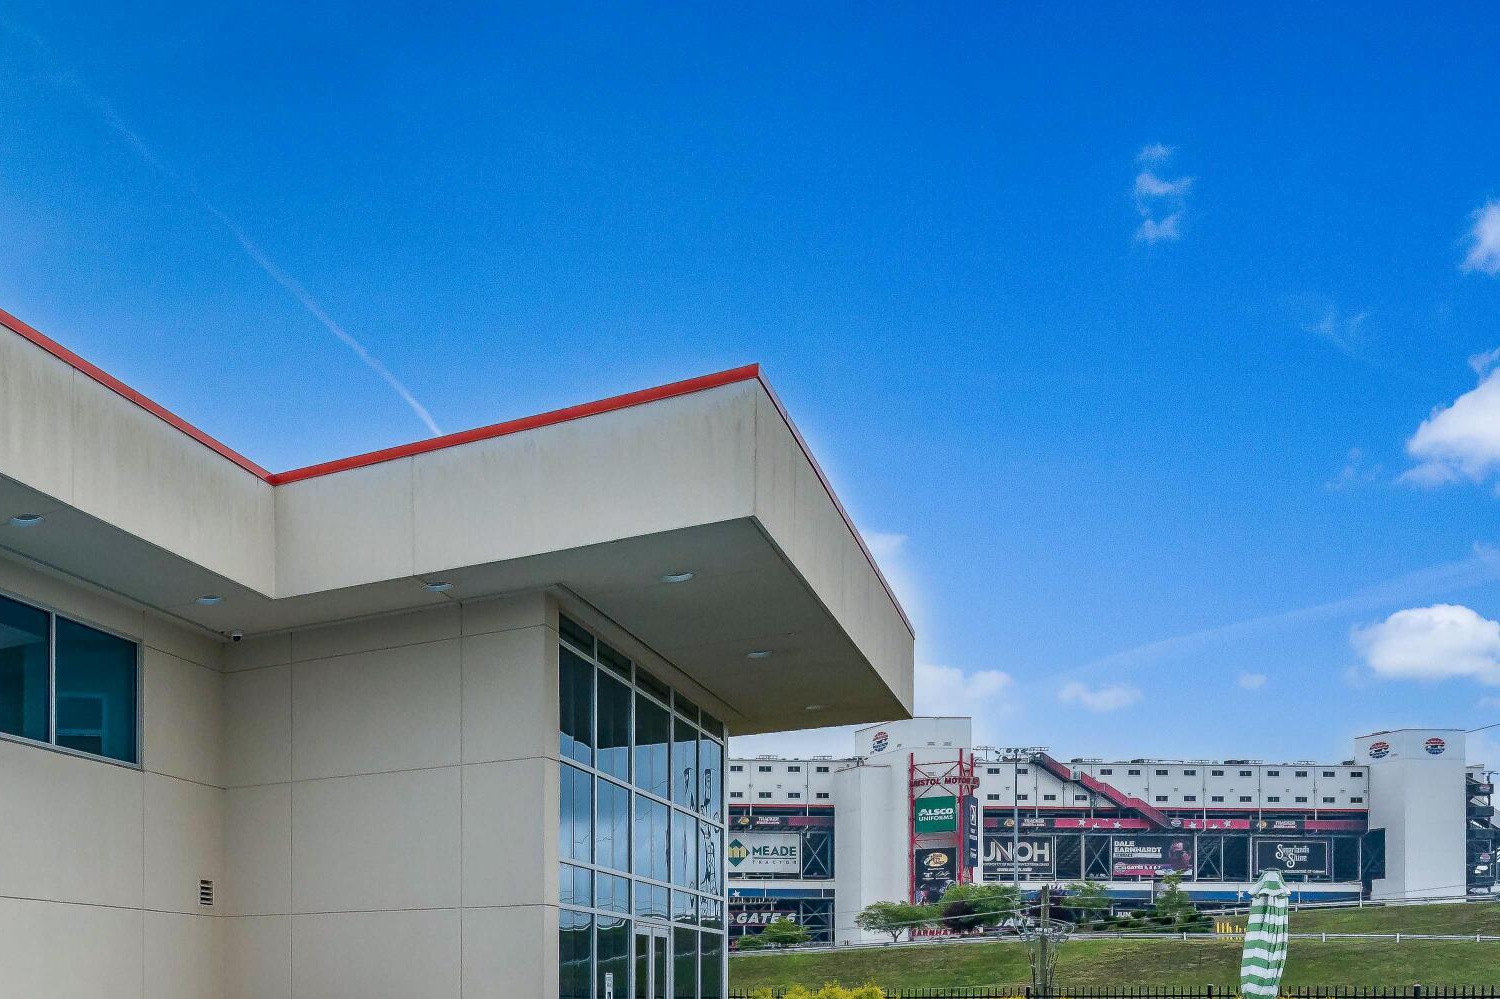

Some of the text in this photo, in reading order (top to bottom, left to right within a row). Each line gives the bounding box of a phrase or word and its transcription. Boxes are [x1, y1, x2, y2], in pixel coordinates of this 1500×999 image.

[909, 777, 941, 788] RISTOL
[918, 808, 954, 816] ALSCO
[752, 846, 797, 857] MEADE
[983, 837, 1050, 862] UNOH
[736, 912, 782, 924] GATE
